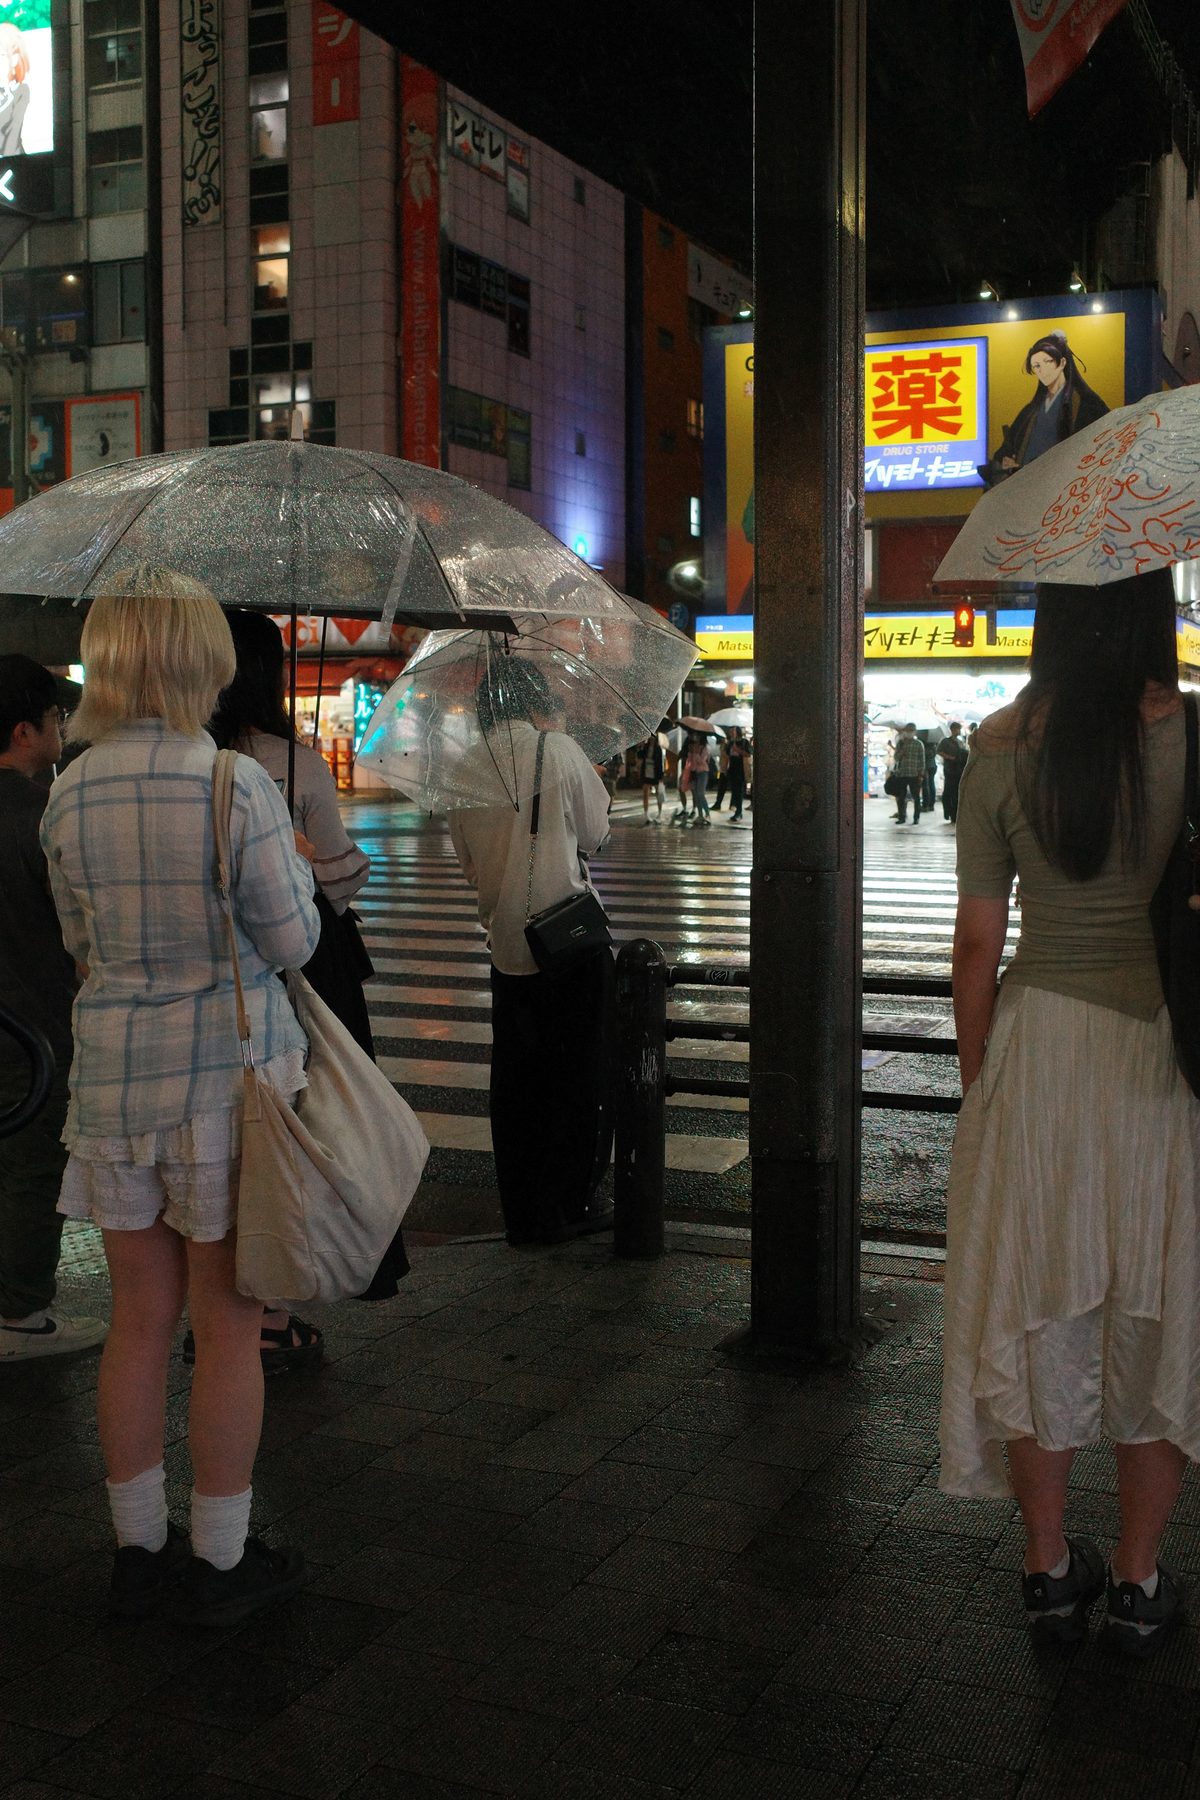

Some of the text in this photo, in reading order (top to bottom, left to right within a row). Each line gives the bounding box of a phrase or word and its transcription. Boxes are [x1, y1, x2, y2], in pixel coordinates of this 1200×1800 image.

[872, 352, 963, 440] 薬
[883, 444, 949, 456] DRUG STORE
